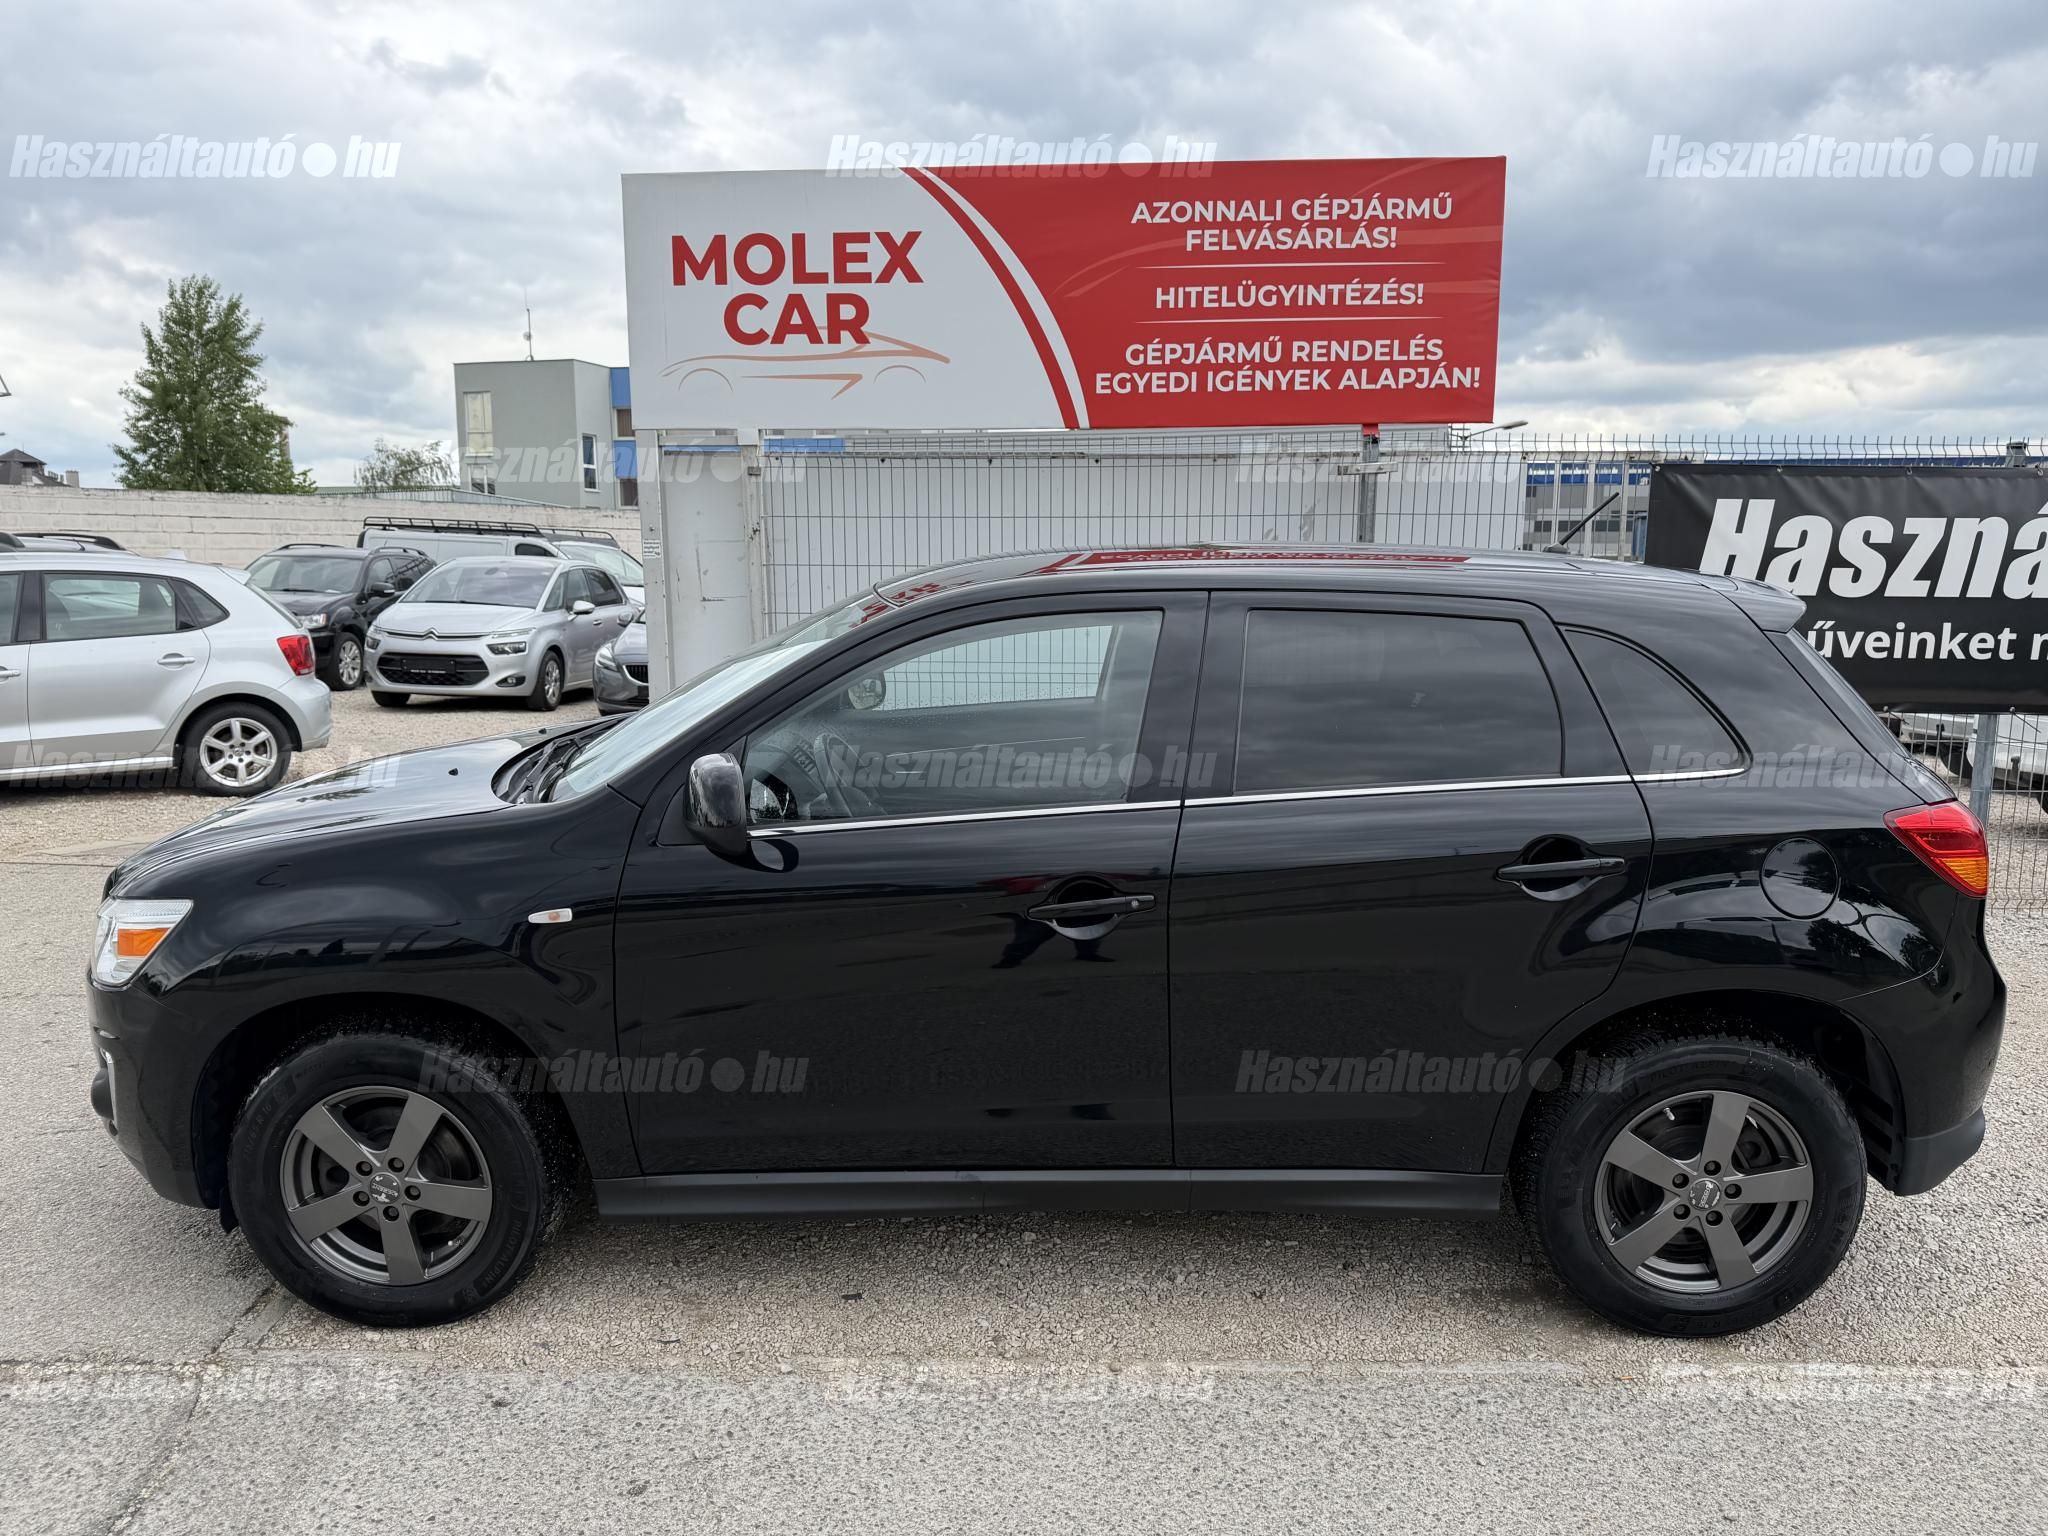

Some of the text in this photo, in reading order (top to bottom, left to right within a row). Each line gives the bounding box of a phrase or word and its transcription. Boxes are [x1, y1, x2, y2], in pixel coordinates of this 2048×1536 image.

[1131, 192, 1453, 224] AZONNALI GÉPJÁRMŰ
[1185, 222, 1397, 251] FELVÁSÁRLÁS!
[671, 231, 925, 286] MOLEX
[1155, 278, 1424, 309] HITELÜGYINTÉZÉS!
[723, 292, 871, 346] CAR
[1125, 334, 1443, 366] GÉPJÁRMŰ RENDELÉS
[1095, 362, 1480, 395] EGYEDI IGÉNYEK ALAPJÁN!
